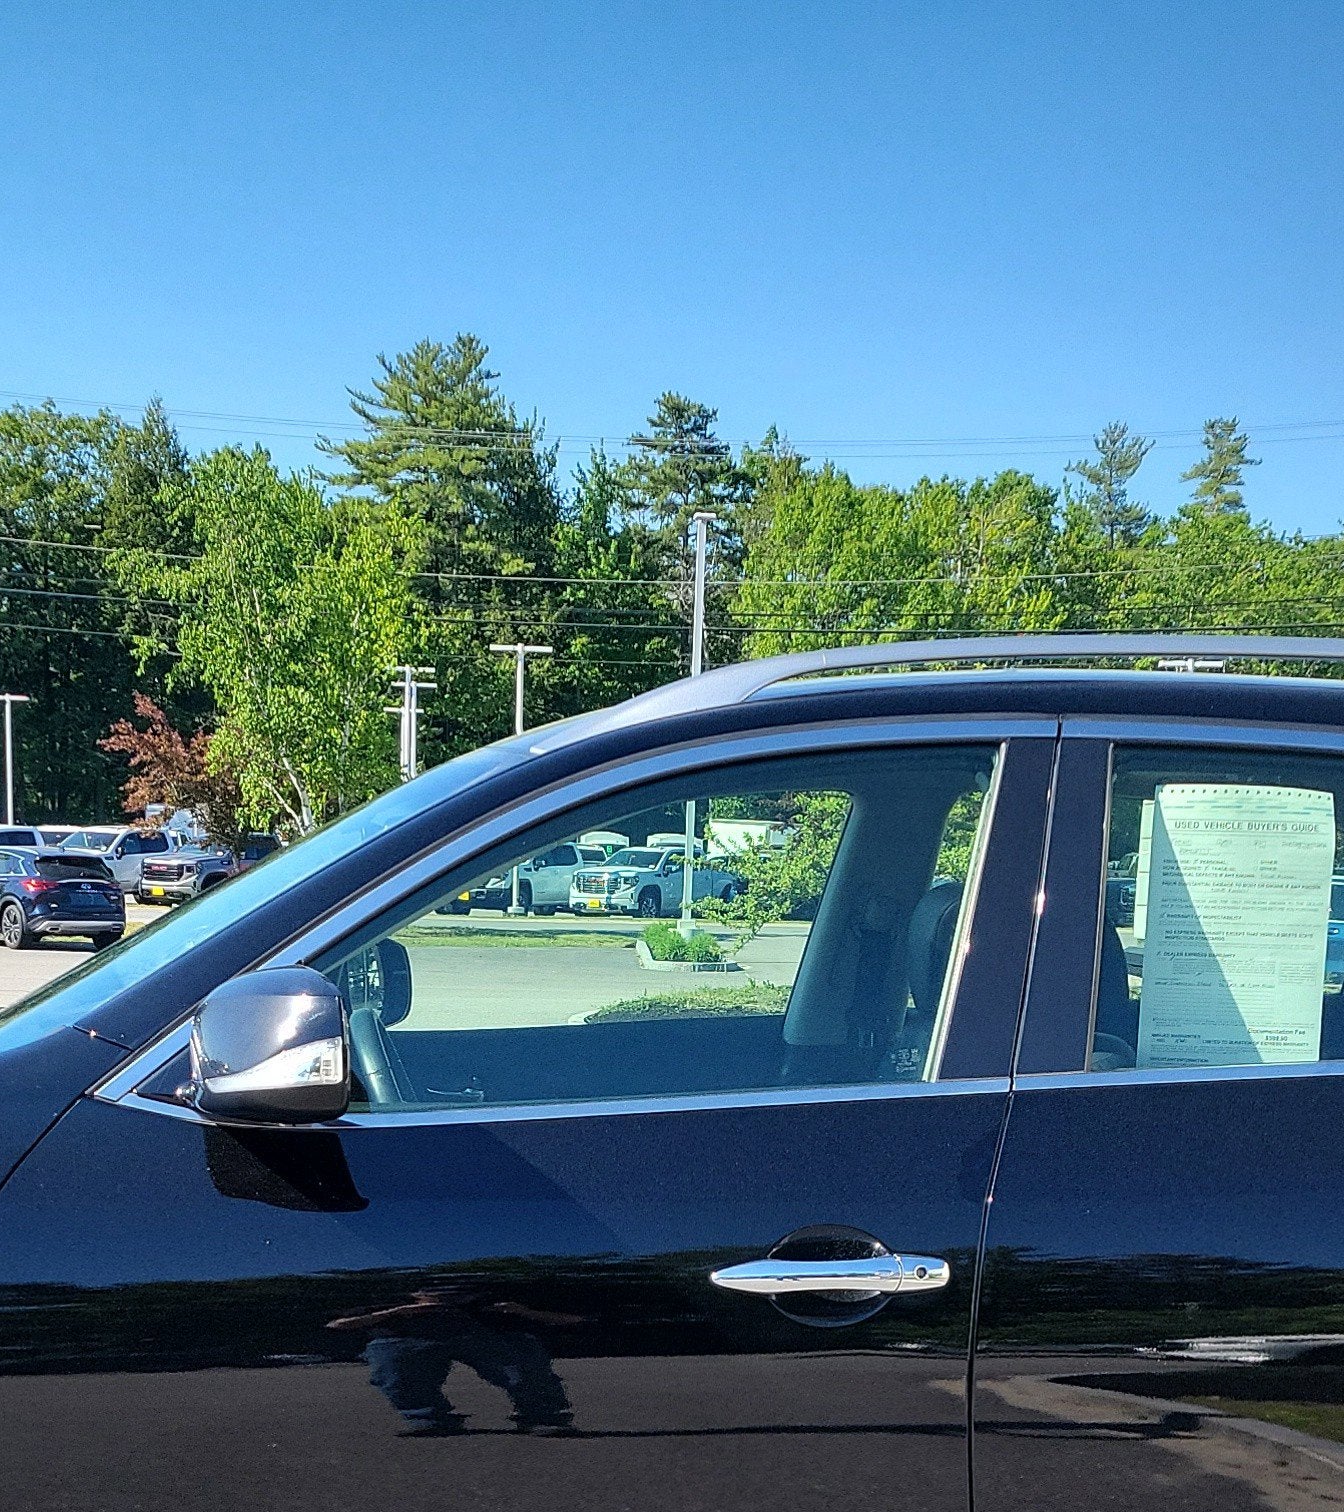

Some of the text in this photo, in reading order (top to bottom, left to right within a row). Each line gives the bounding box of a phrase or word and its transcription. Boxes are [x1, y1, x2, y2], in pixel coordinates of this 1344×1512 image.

[1174, 820, 1319, 833] USED VEHICLE BUYER'S GUIDE
